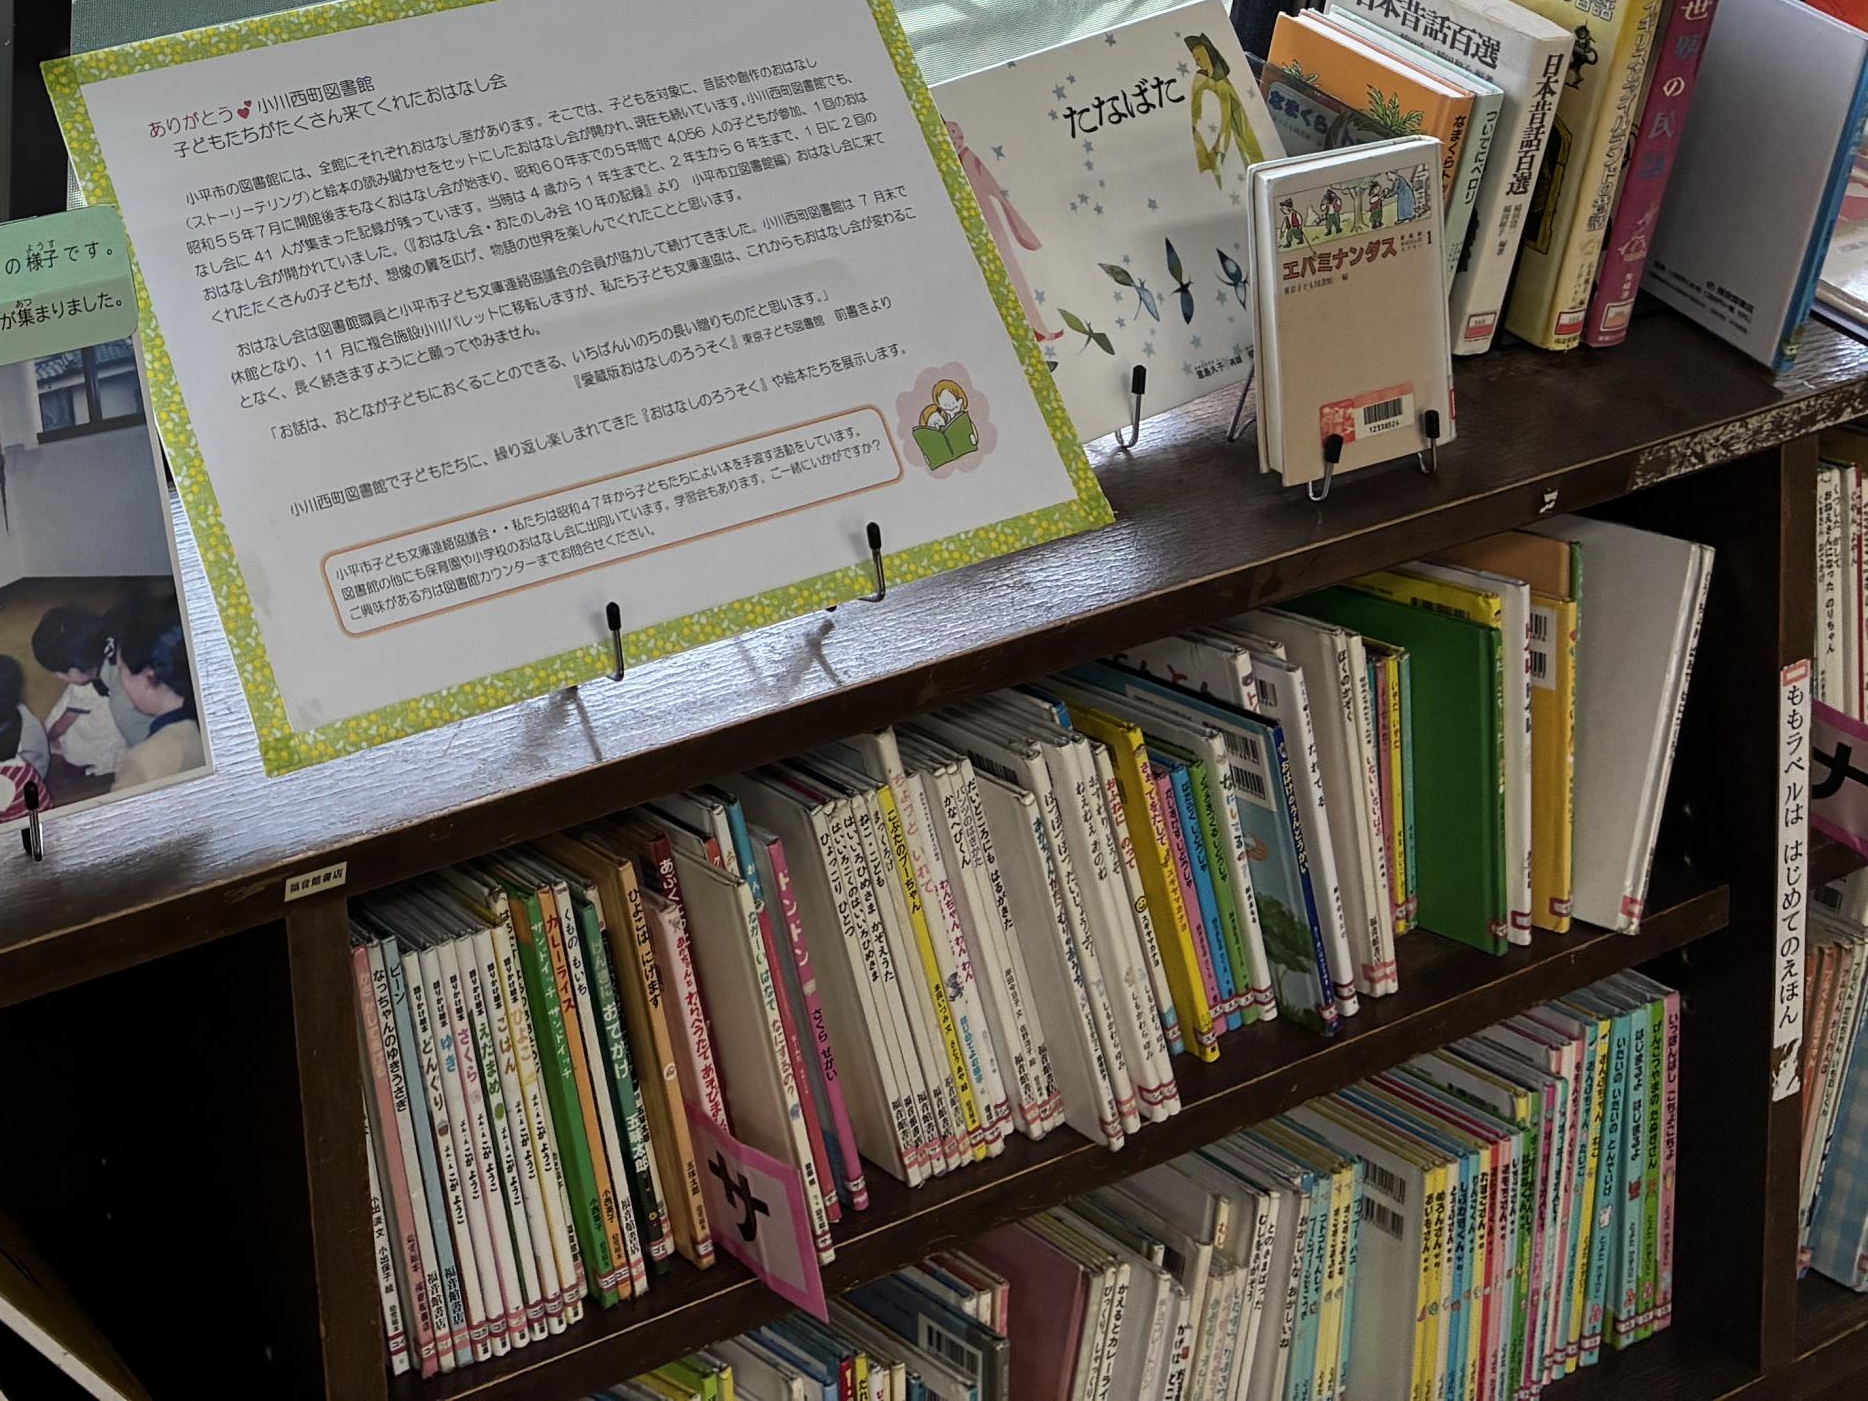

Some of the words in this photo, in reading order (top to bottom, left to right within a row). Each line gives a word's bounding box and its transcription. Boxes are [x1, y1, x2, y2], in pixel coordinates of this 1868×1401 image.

[149, 105, 233, 139] ありがとう
[257, 75, 375, 114] 小川西町図書館
[172, 73, 508, 159] 子どもたちがたくさん来てくれたおはなし会
[185, 57, 818, 205] 小平市の図書館には、全館にそれぞれおはなし室があります。そこでは、子どもを対象に、昔話や創作のおはなし
[1063, 76, 1185, 139] たなばた
[1505, 53, 1565, 196] 日本昔話百選
[1465, 109, 1499, 205] ついでにペロリ
[211, 189, 742, 326] くれたたくさんの子どもが、想像の翼を広げ、物語の世界を楽しんでくれたことと思います。
[239, 324, 541, 410] となく、長く続きますようにと願ってやみません。
[348, 525, 656, 622] ご興味がある方は図書館カウンターまでお問合せください。
[1783, 684, 1806, 828] ももラベルは
[893, 772, 918, 837] ちょっと
[912, 846, 935, 893] いれて
[944, 795, 972, 870] かなへびくん
[956, 785, 984, 869] パンツのはきかた
[1076, 781, 1096, 837] ねえねえ
[1091, 840, 1108, 882] あのね
[1089, 776, 1109, 829] おすわり
[820, 833, 843, 895] ひょっこり
[838, 901, 855, 937] ひとつ
[860, 814, 885, 888] ねこ・こども
[967, 778, 996, 865] だいどころにも
[989, 868, 1015, 933] はるがきた
[1121, 838, 1135, 870] のって
[778, 871, 810, 966] ドンドン
[830, 820, 881, 984] はいいろこくのはいいろひめさま
[843, 815, 877, 916] はいいろひめさま
[871, 922, 895, 983] かぞえうた
[939, 878, 961, 933] わんちゃん
[1777, 839, 1805, 1030] はじめてのえほん
[546, 915, 576, 1013] カレーライス
[628, 888, 650, 945] ひよこは
[642, 951, 662, 1009] にげます
[373, 969, 407, 1113] なっちゃんのゆきうさぎ
[422, 1037, 444, 1111] どんぐり
[440, 1035, 456, 1072] ゆき
[457, 1028, 477, 1082] さくら
[478, 1022, 501, 1095] えだまめ
[513, 1008, 530, 1061] ひよこ
[602, 1003, 629, 1079] おでかけ
[812, 1008, 828, 1043] さくら
[821, 1048, 838, 1082] せかい
[708, 1150, 769, 1243] サ
[1291, 1216, 1308, 1278] おかしいな
[1279, 1286, 1297, 1349] おかしいな
